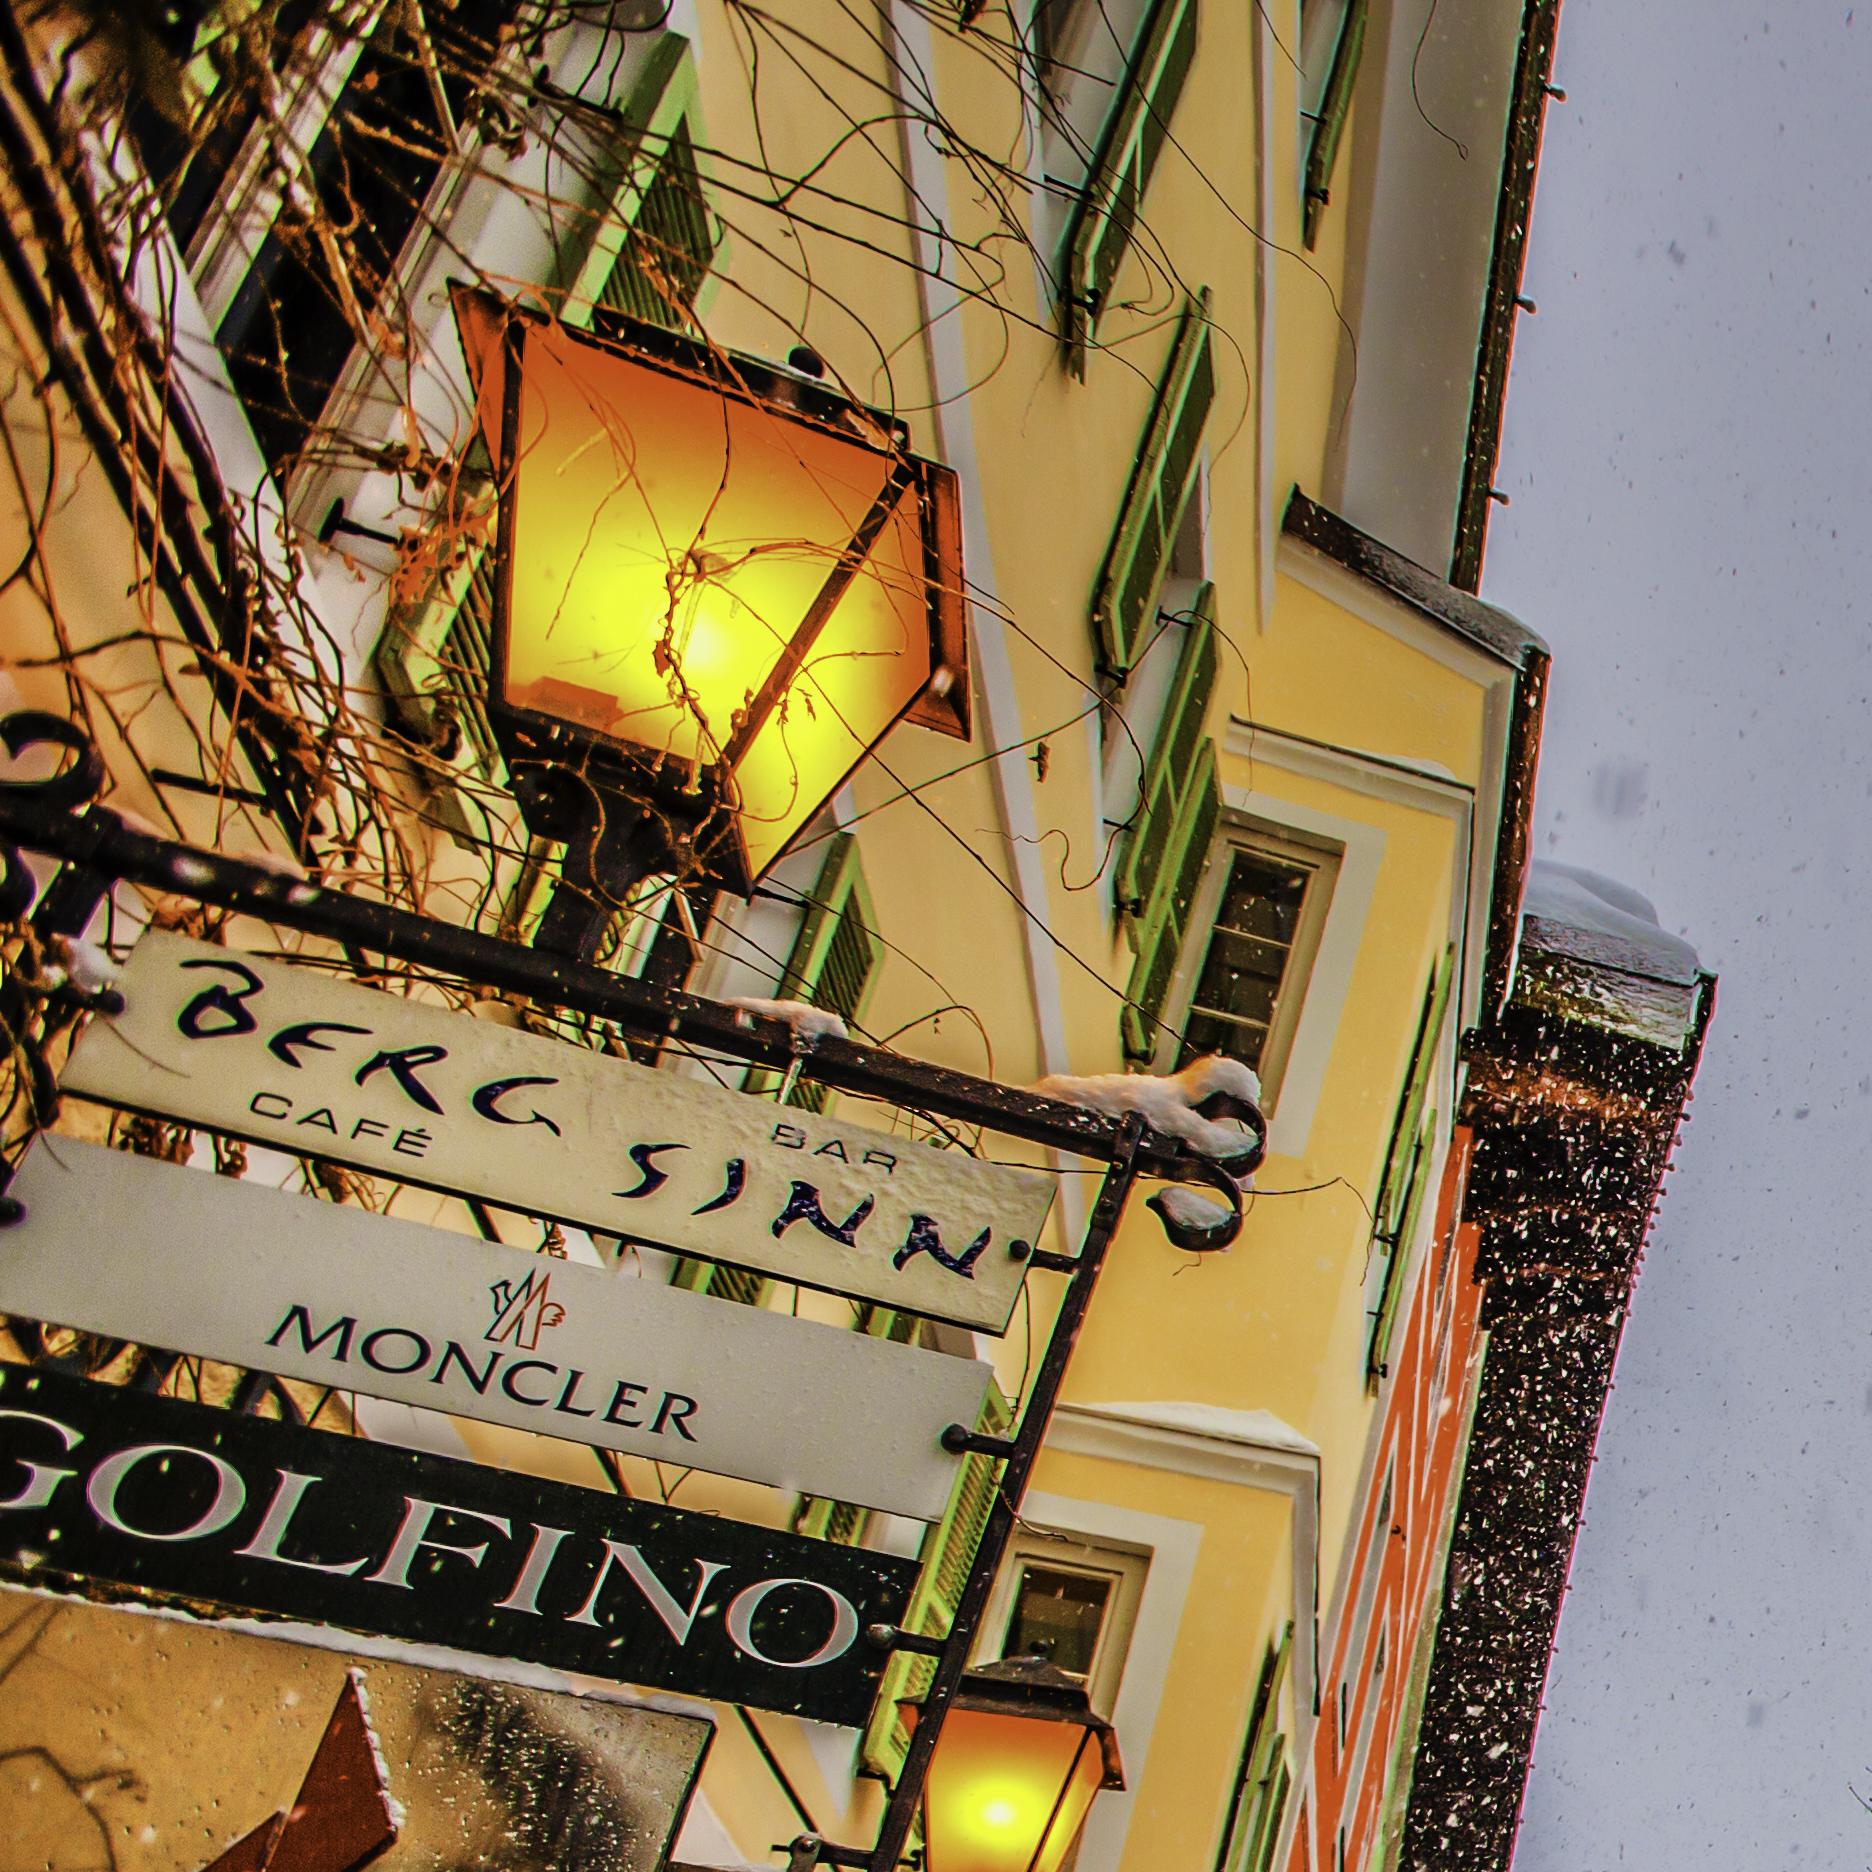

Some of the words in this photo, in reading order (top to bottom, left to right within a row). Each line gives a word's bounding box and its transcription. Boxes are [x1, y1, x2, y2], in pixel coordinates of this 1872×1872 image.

[177, 957, 562, 1138] BERG
[612, 1141, 992, 1281] SINN
[249, 1090, 434, 1158] CAFÉ
[770, 1121, 901, 1176] BAR
[264, 1304, 699, 1445] MONCLER
[0, 1411, 861, 1669] GOLFINO
